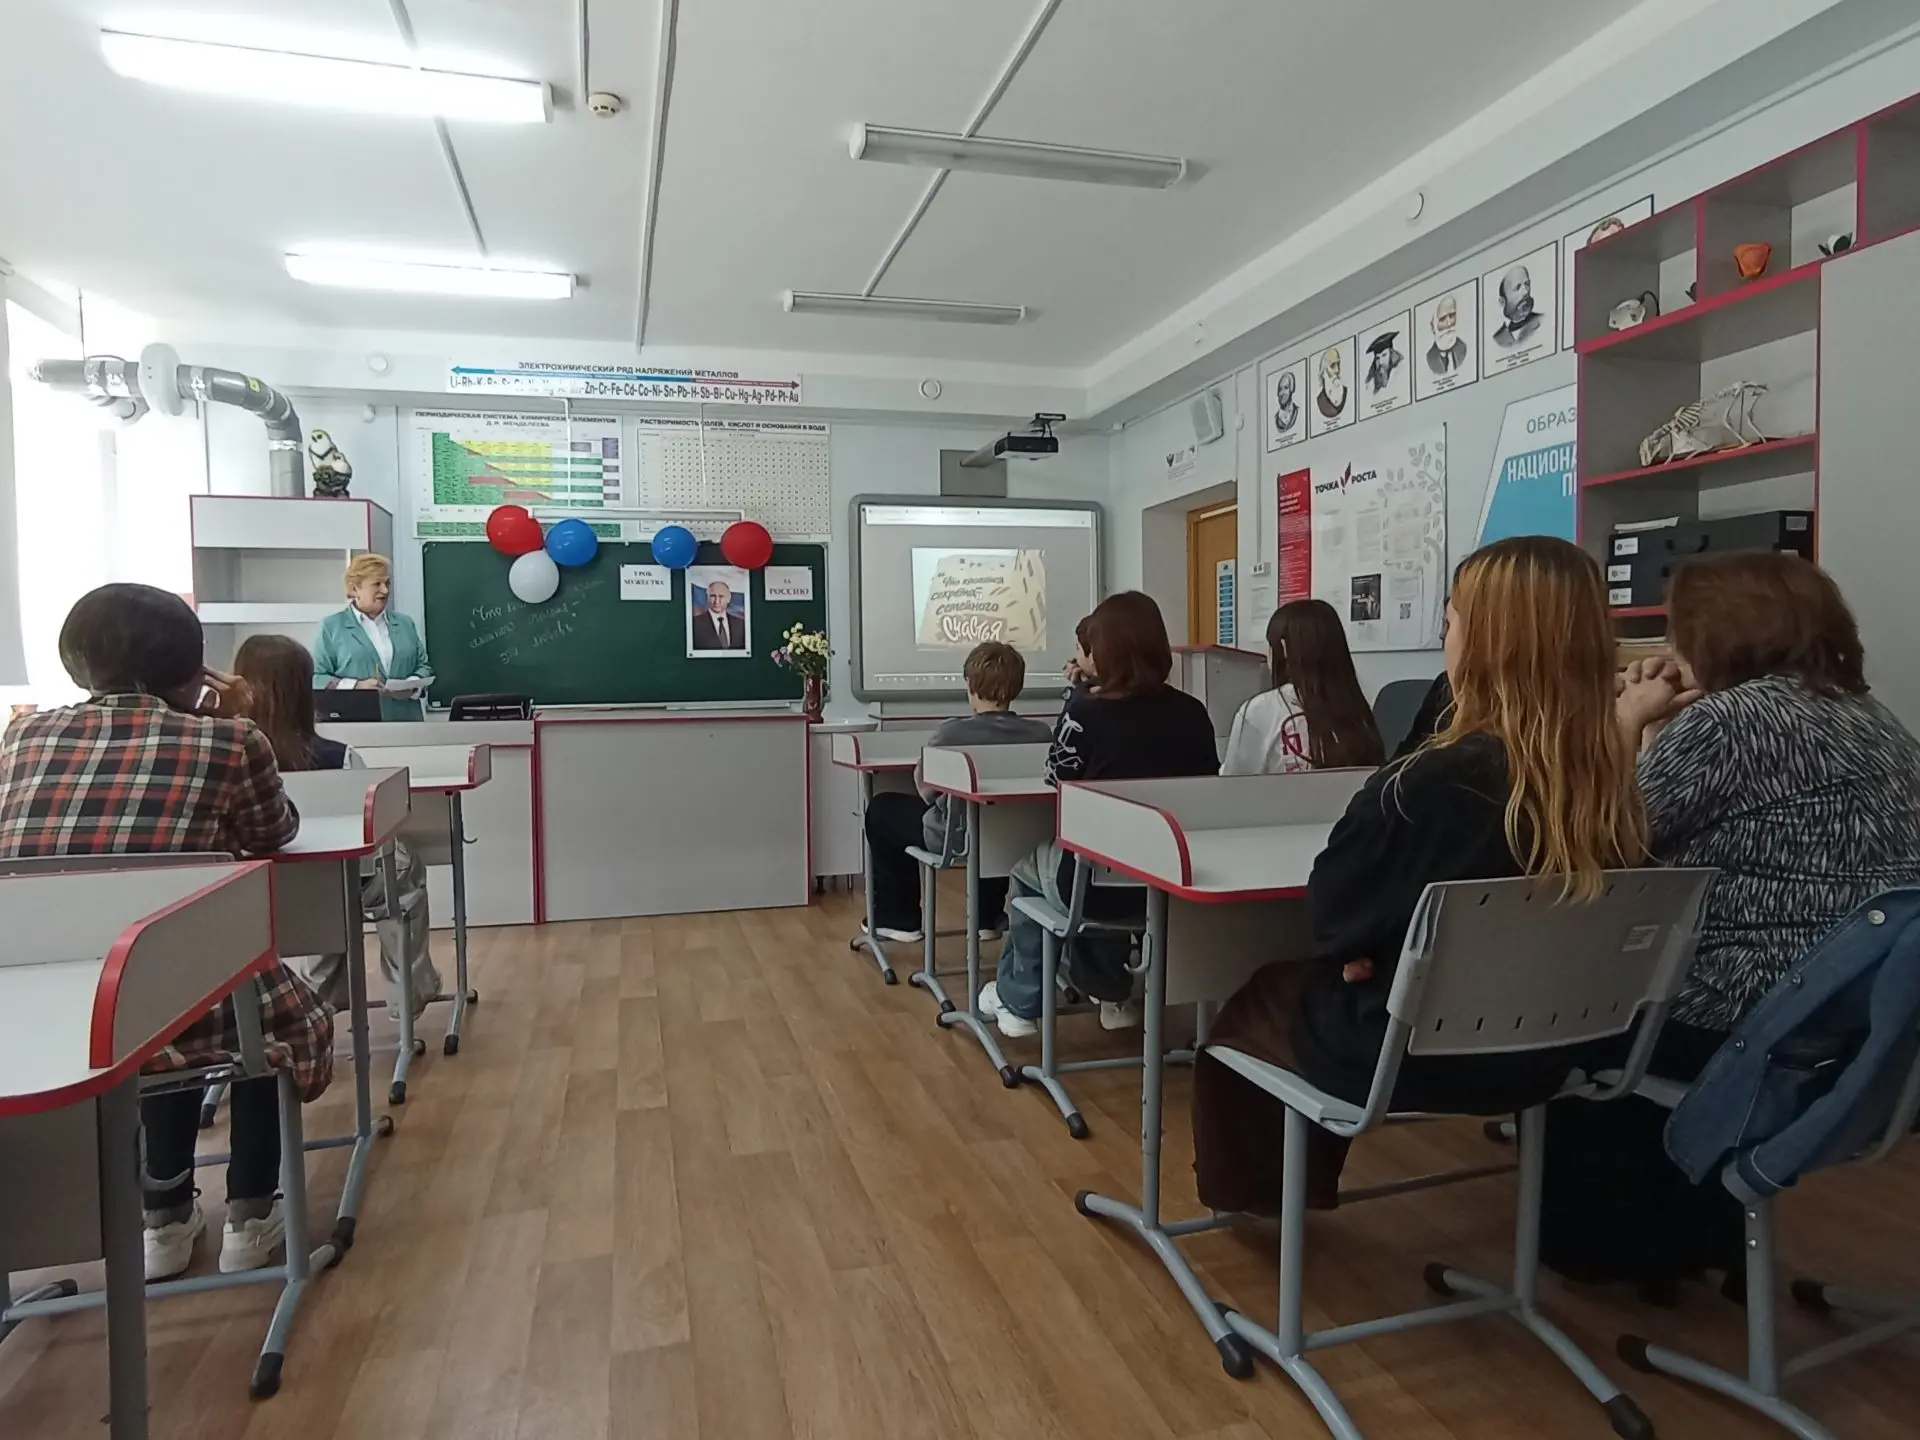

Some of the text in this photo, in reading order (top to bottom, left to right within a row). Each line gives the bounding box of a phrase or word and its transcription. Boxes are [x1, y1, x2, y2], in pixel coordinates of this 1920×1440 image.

[518, 362, 739, 379] ЭЛЕКТРОХИМИЧЕСКИЙ РЯД НАПРЯЖЕНИЙ МЕТАЛЛОВ
[1526, 406, 1577, 434] ОБРАЗ
[1315, 470, 1378, 495] ТОЧКА РОСТА
[769, 588, 809, 596] РОССИЮ
